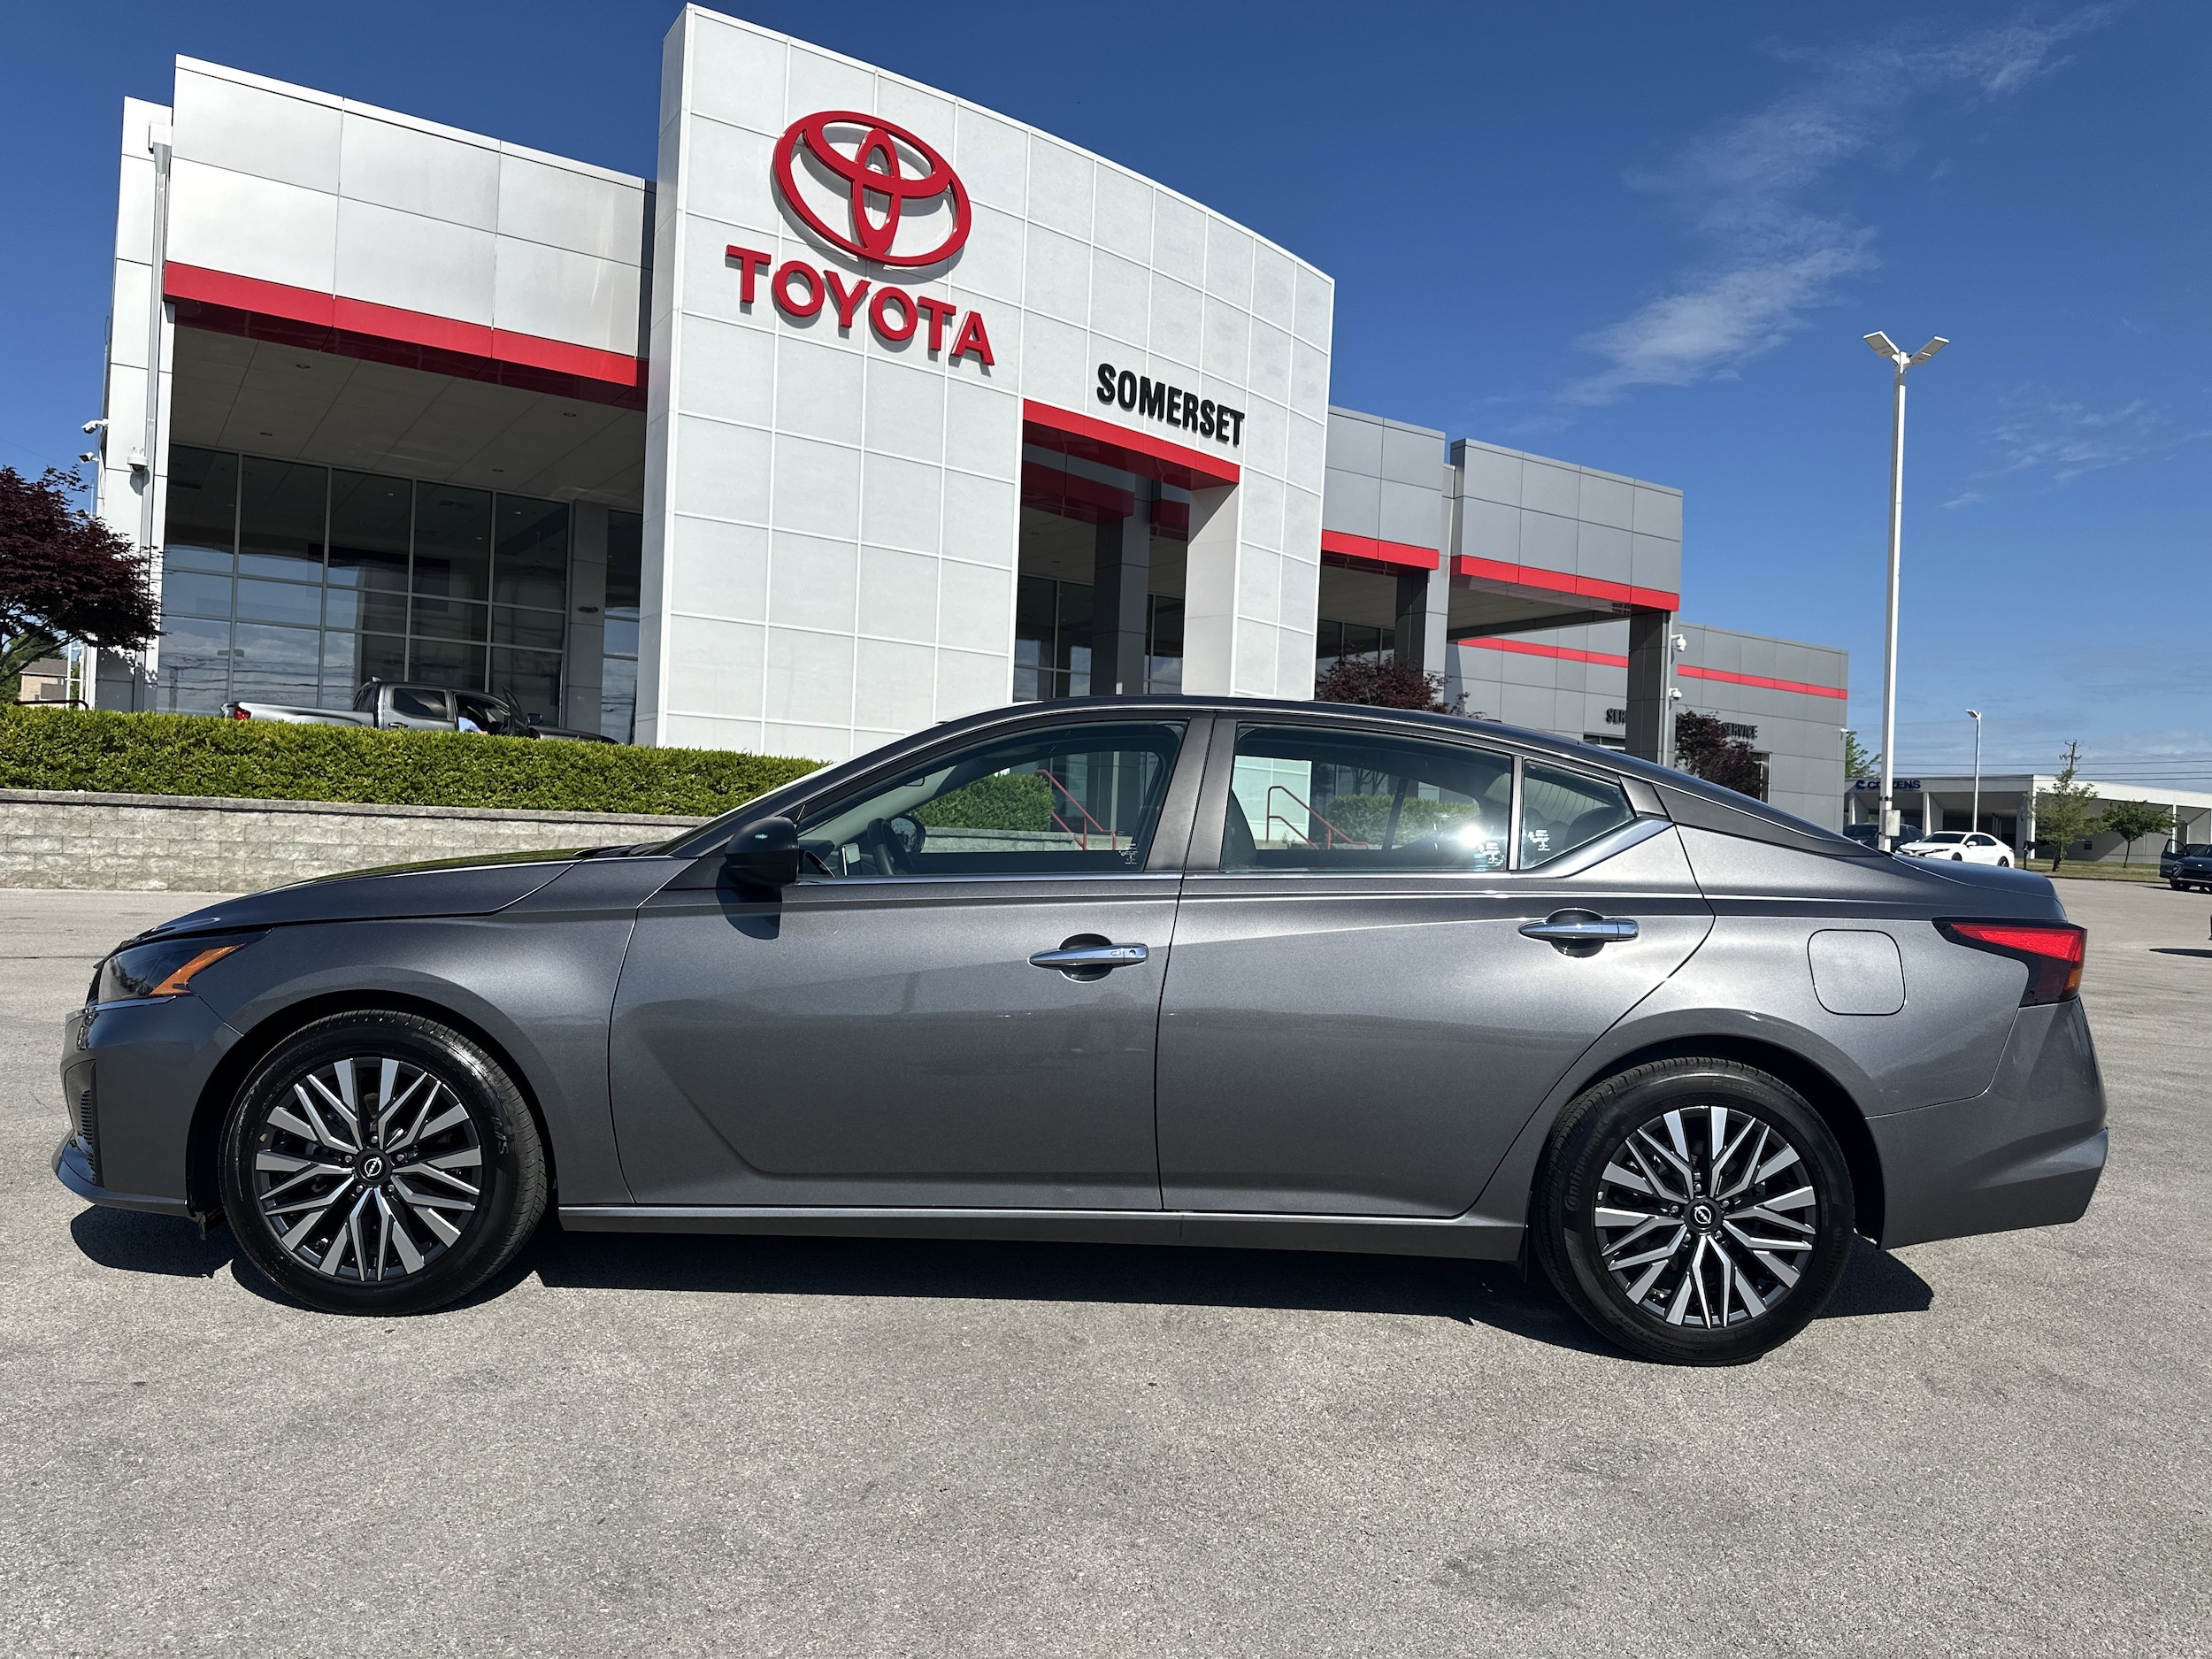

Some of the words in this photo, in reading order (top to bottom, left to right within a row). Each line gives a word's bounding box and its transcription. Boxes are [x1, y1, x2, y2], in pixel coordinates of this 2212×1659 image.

[726, 244, 995, 366] TOYOTA
[1096, 363, 1245, 446] SOMERSET
[1867, 780, 1921, 789] CIZENS
